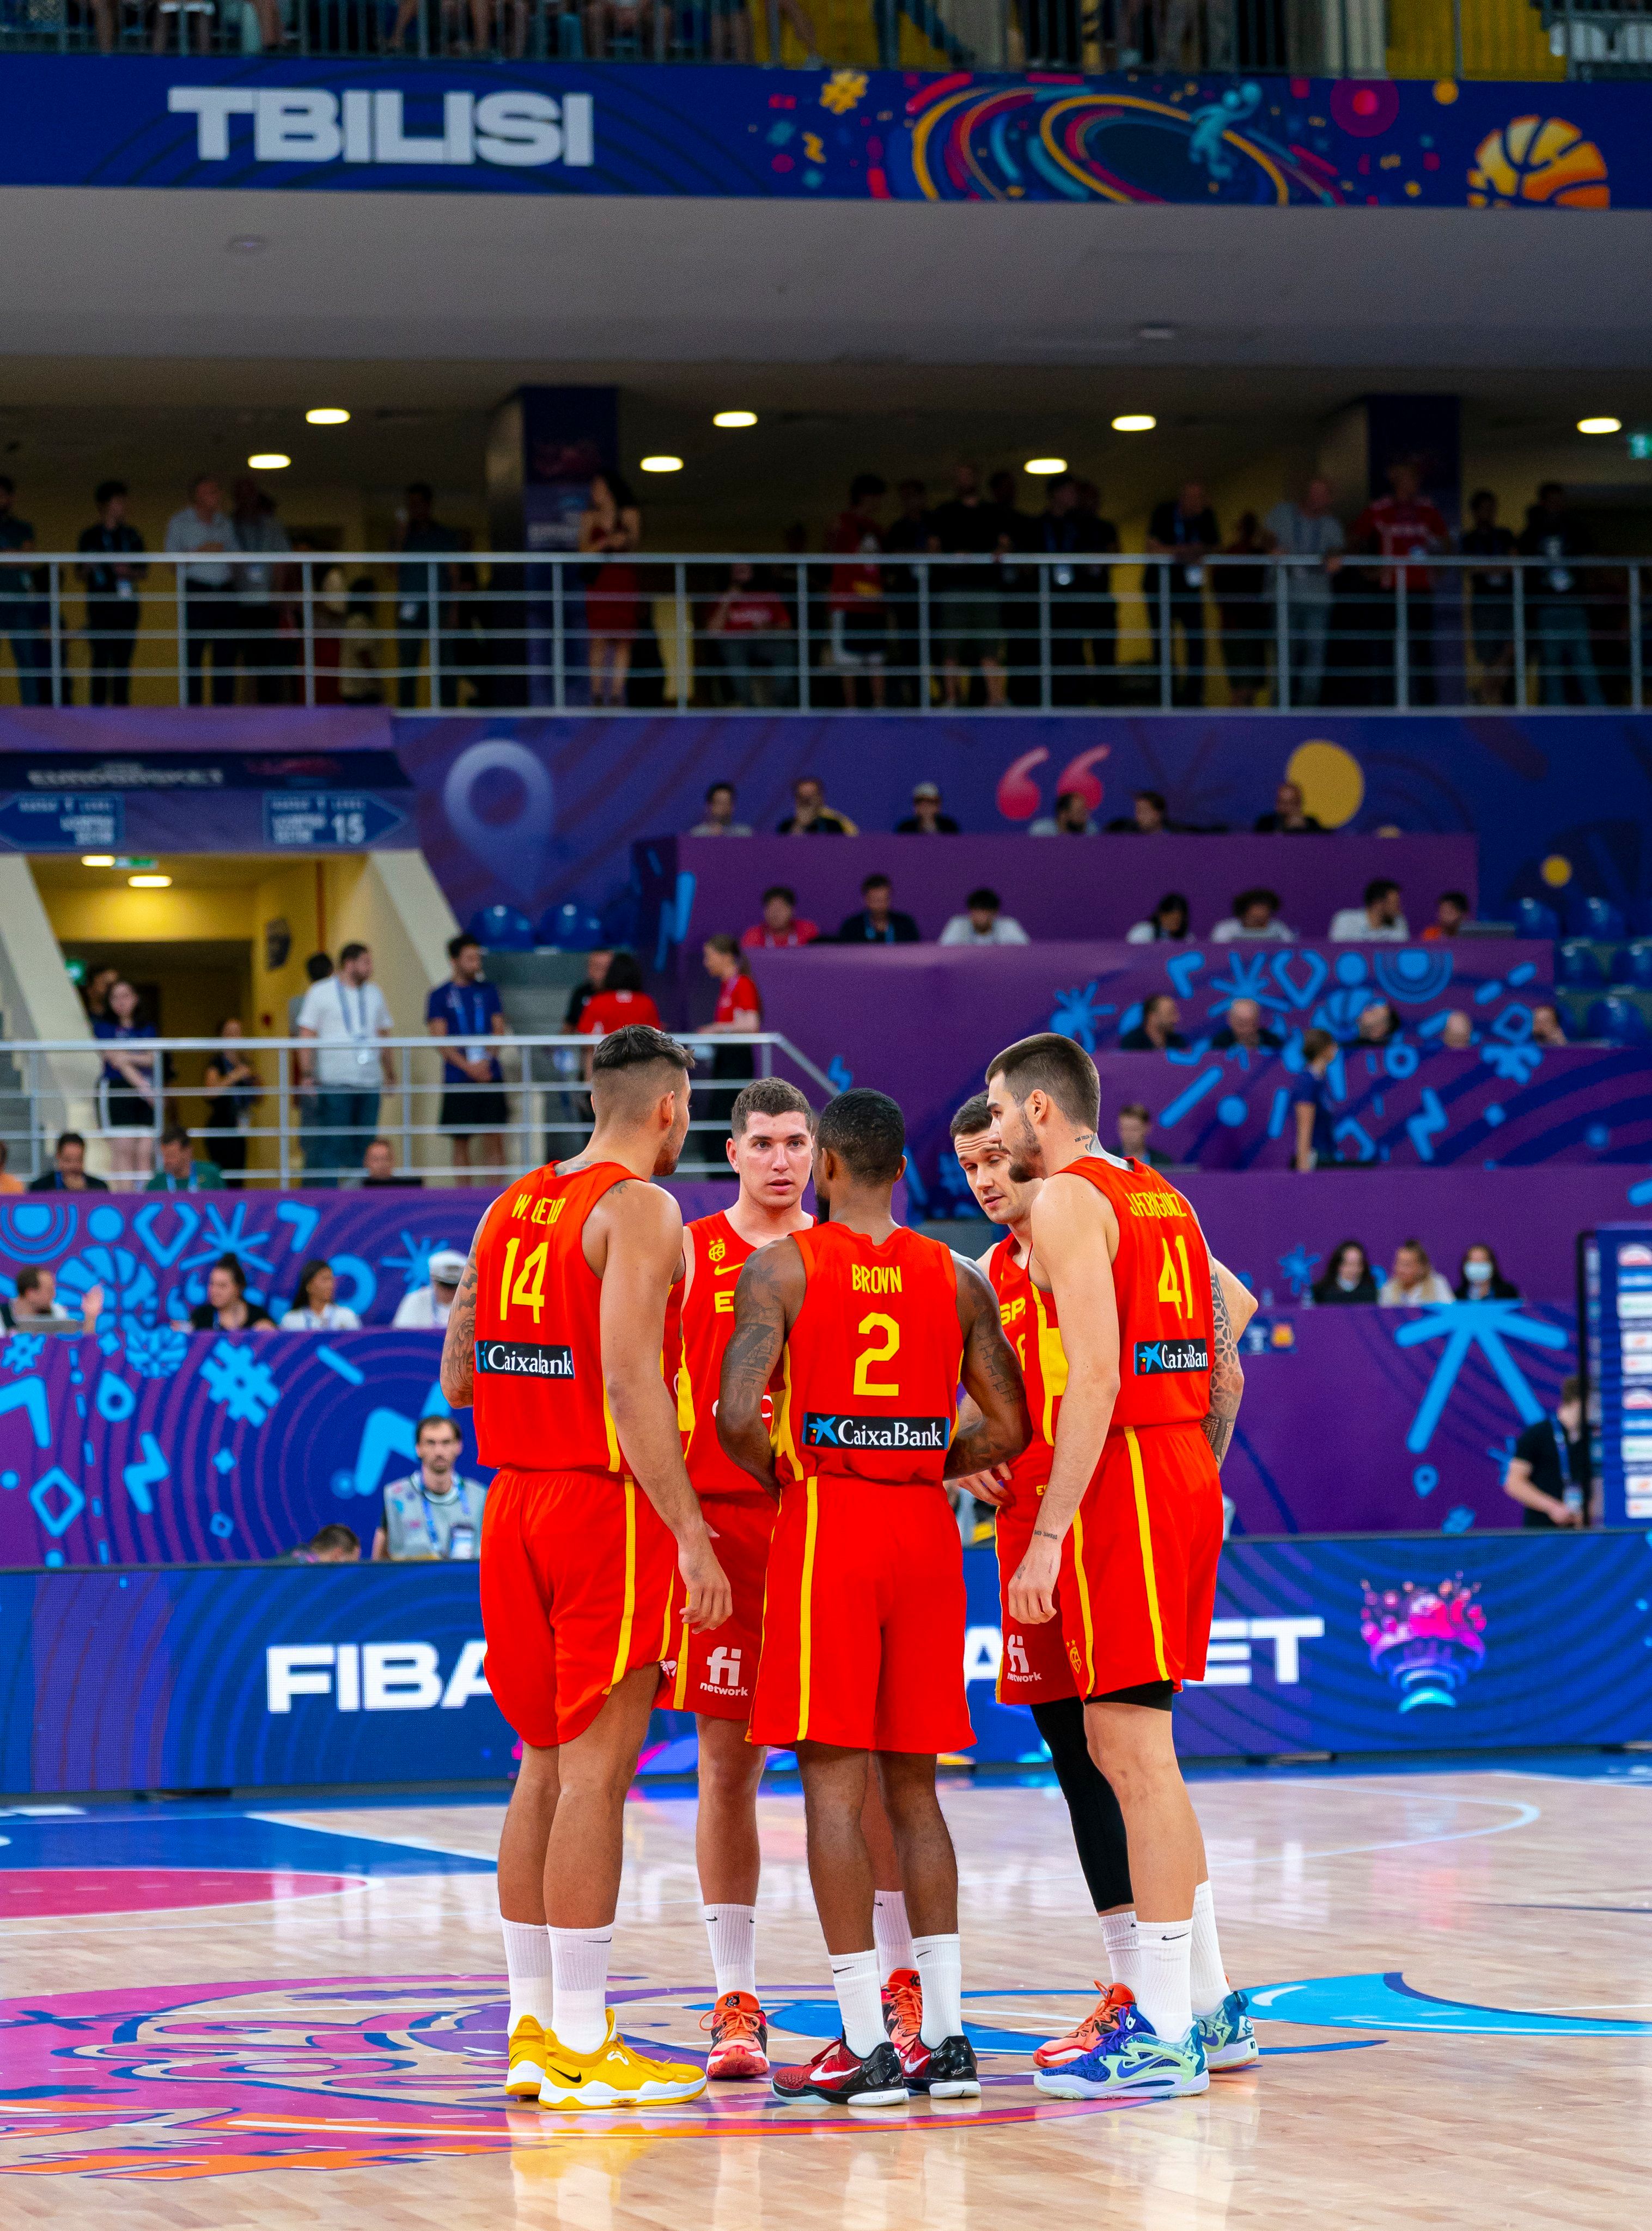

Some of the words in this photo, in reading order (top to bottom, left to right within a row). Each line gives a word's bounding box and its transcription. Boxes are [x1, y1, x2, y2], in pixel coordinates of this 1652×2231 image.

[169, 87, 595, 166] TBILISI
[511, 1194, 532, 1220] W.
[500, 1238, 548, 1324] 14
[852, 1264, 903, 1294] BROWN
[1158, 1235, 1193, 1319] 41
[488, 1345, 573, 1375] Caixaank
[854, 1312, 899, 1396] 2
[838, 1420, 942, 1446] CaixaBank
[706, 1647, 741, 1686] fi
[700, 1682, 748, 1696] network
